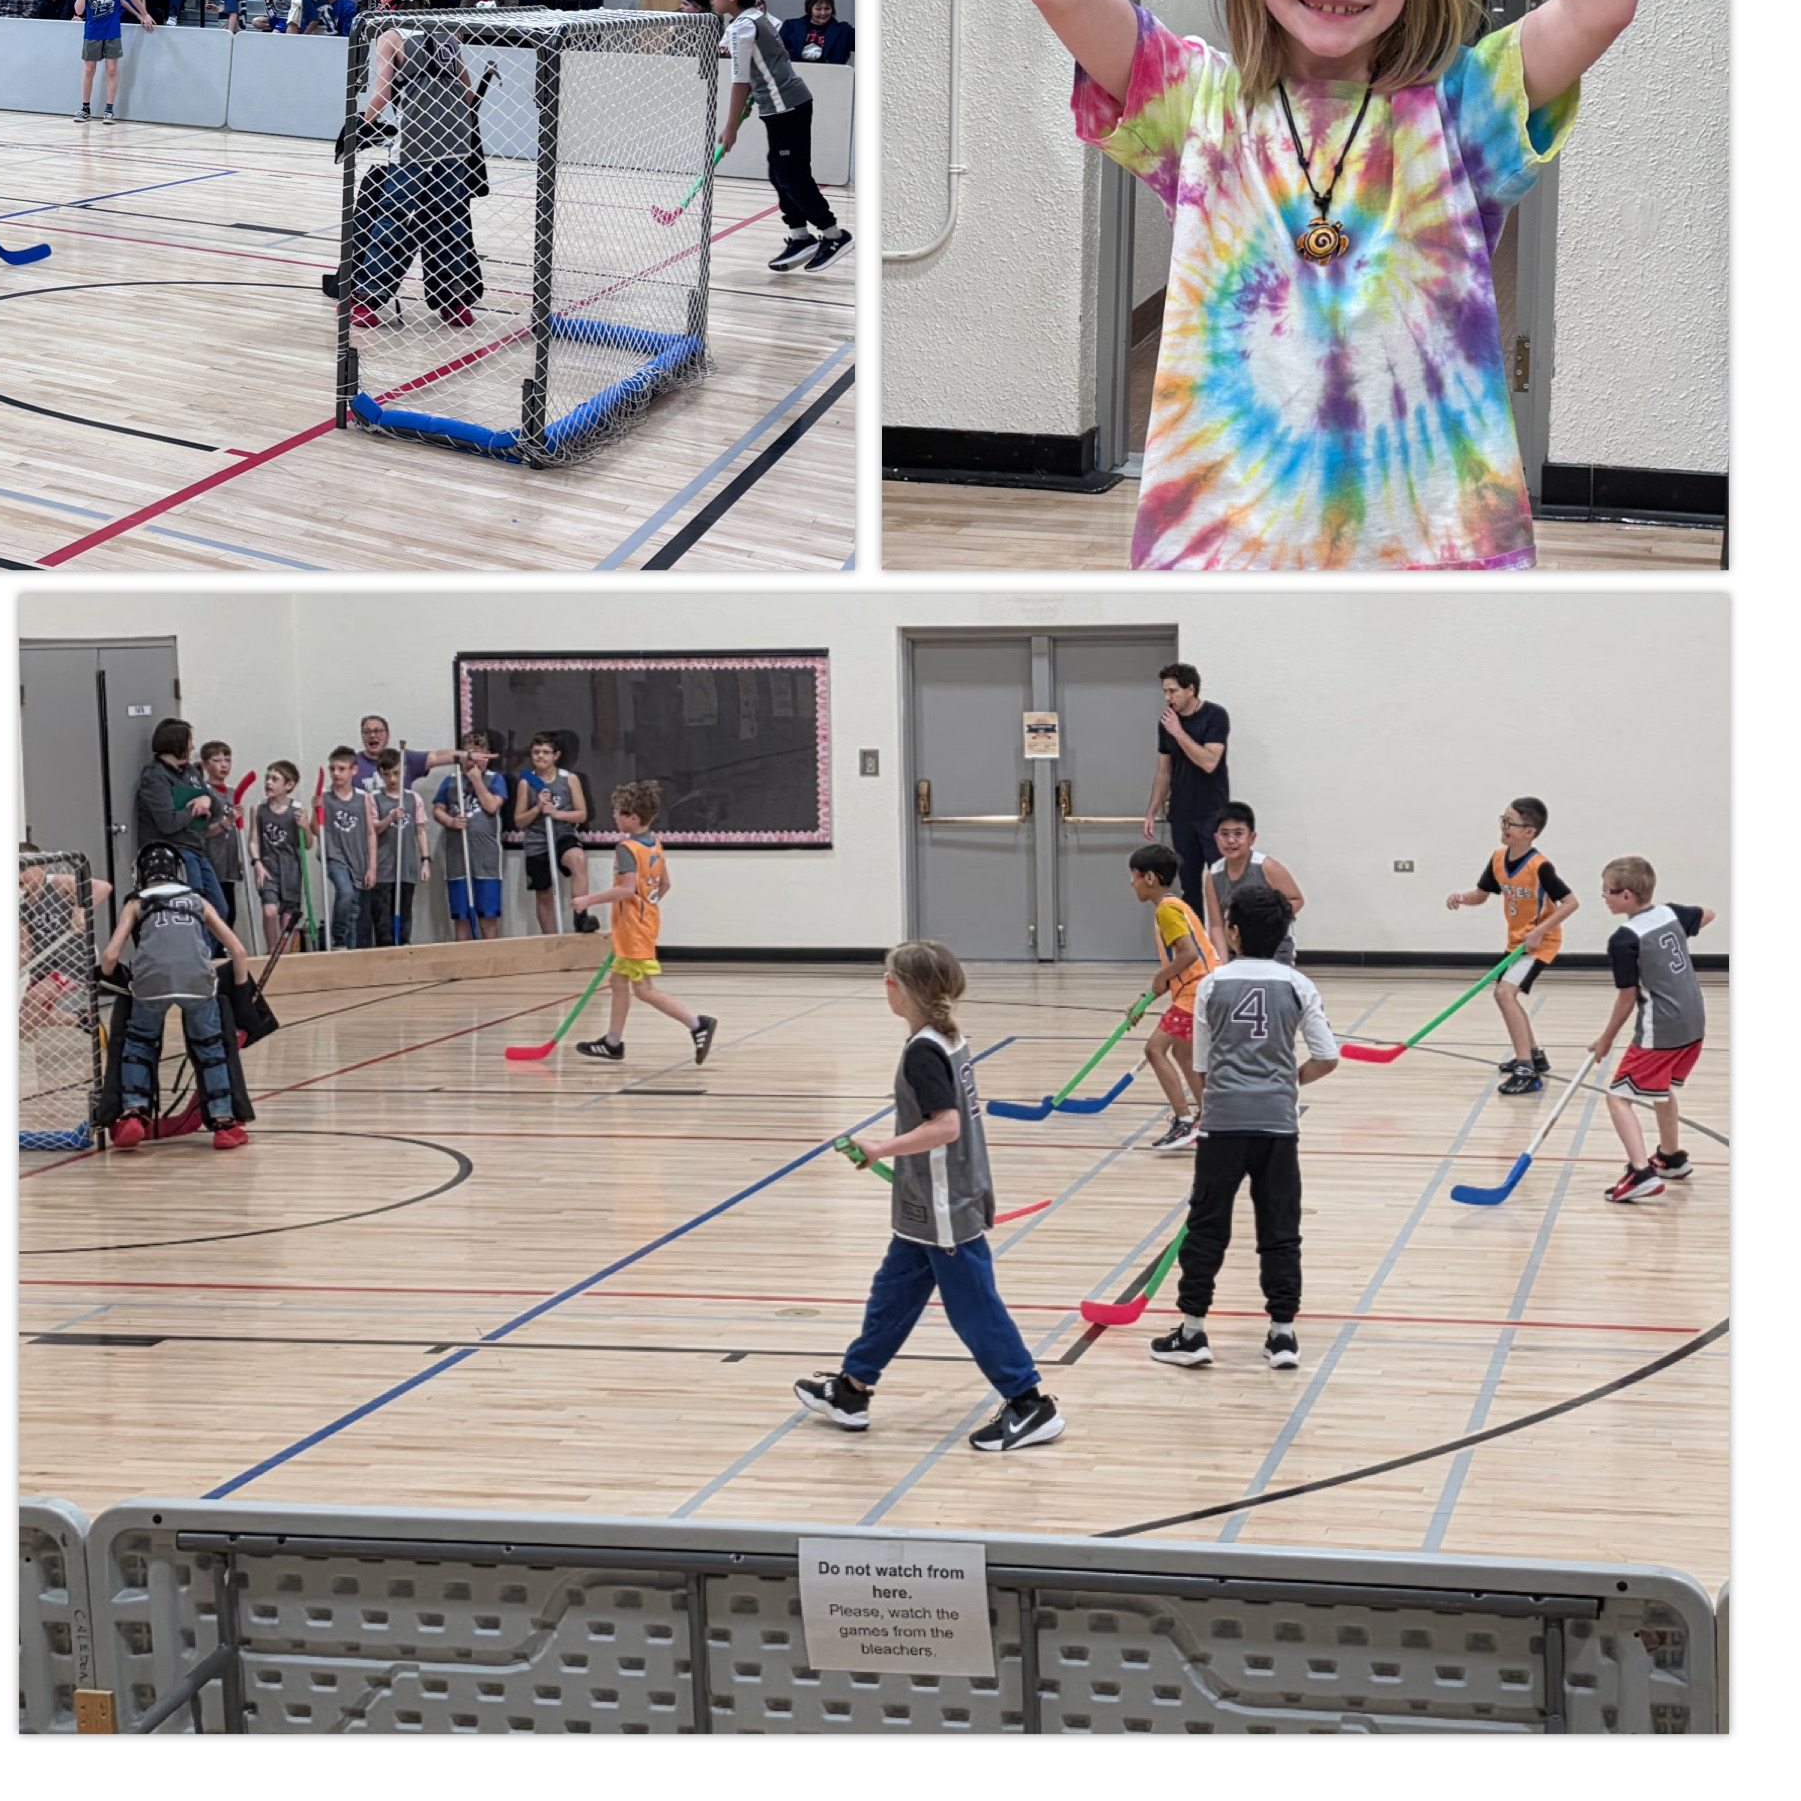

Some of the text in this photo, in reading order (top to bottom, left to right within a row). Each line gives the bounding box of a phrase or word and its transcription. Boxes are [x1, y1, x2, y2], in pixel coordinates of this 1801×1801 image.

[1659, 932, 1687, 974] 3
[1231, 987, 1269, 1039] 4
[818, 1561, 964, 1580] Do not watch from
[872, 1585, 913, 1600] here.
[829, 1603, 959, 1620] Please, watch the
[839, 1625, 954, 1639] games from the
[861, 1643, 937, 1658] bleachers.
